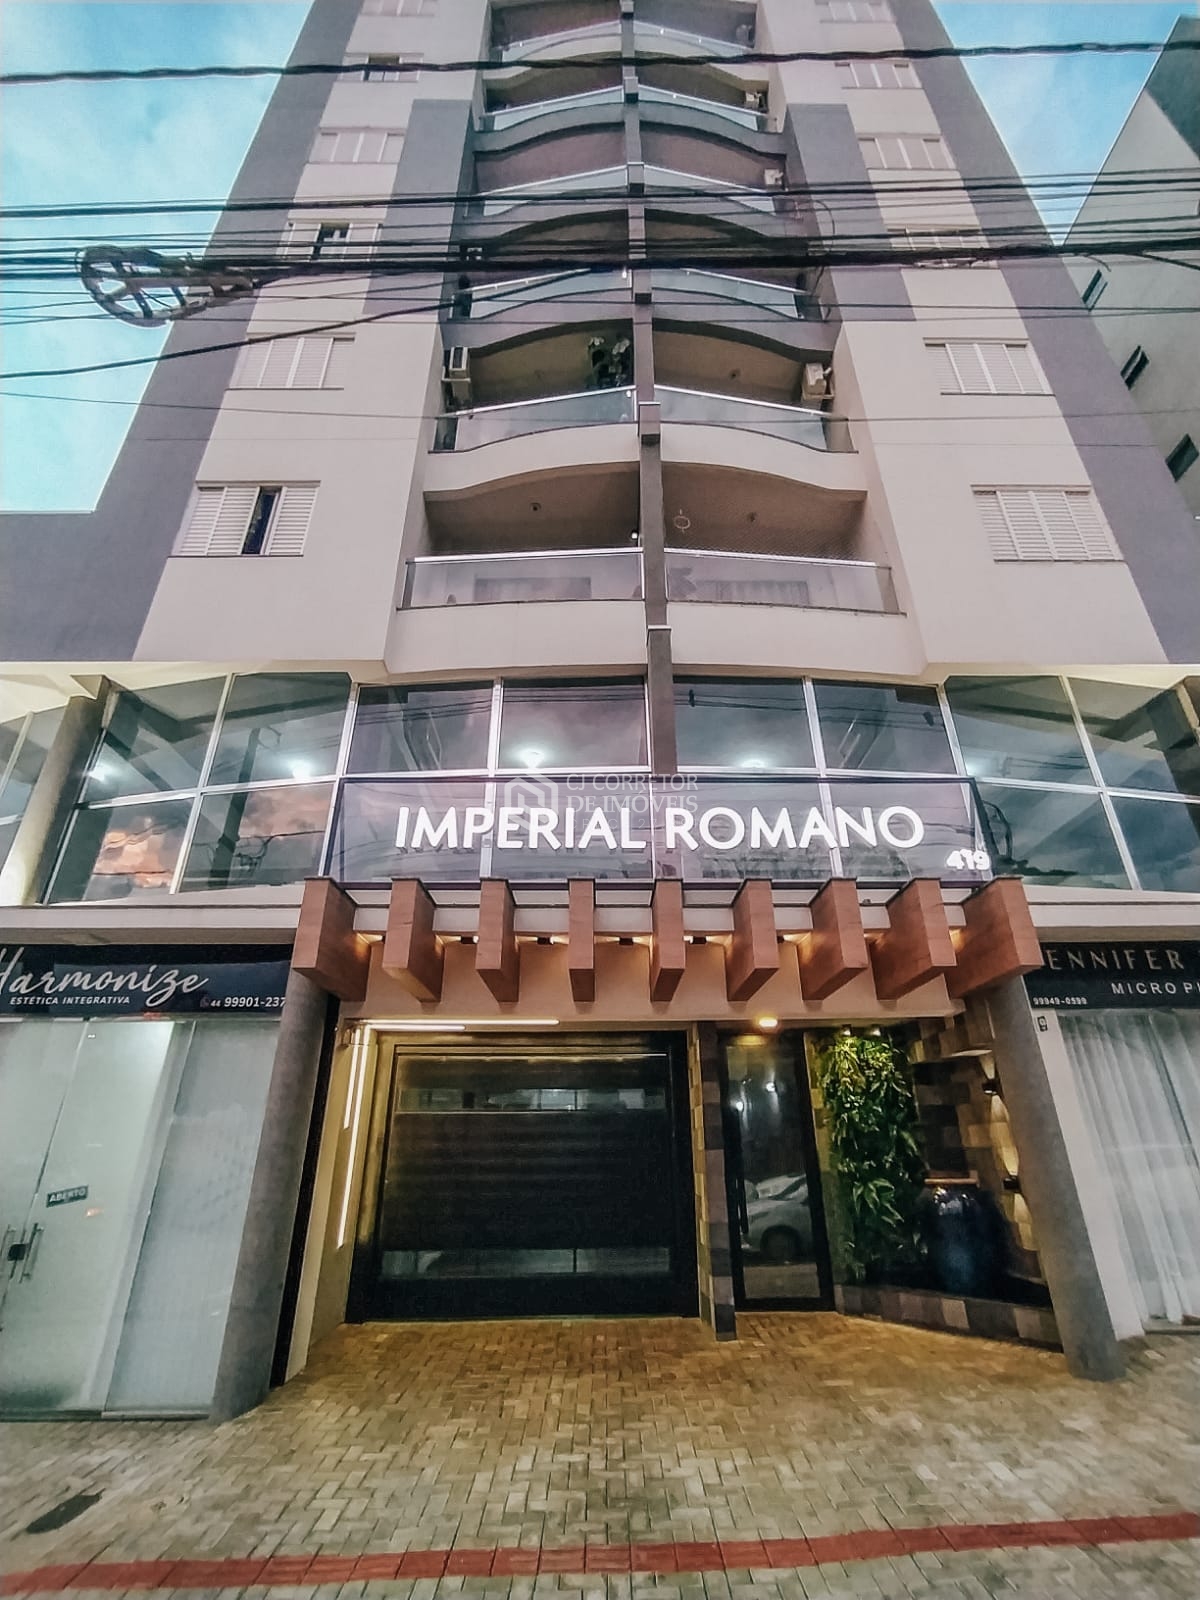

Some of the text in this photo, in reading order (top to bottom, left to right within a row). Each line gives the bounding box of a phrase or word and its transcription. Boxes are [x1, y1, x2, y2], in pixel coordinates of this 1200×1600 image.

[395, 805, 924, 850] IMPERIAL ROMANO
[946, 848, 990, 870] 419
[1111, 982, 1177, 994] MICRO
[62, 996, 130, 1005] INTEGRATIVA
[49, 1187, 86, 1202] ABERTO
